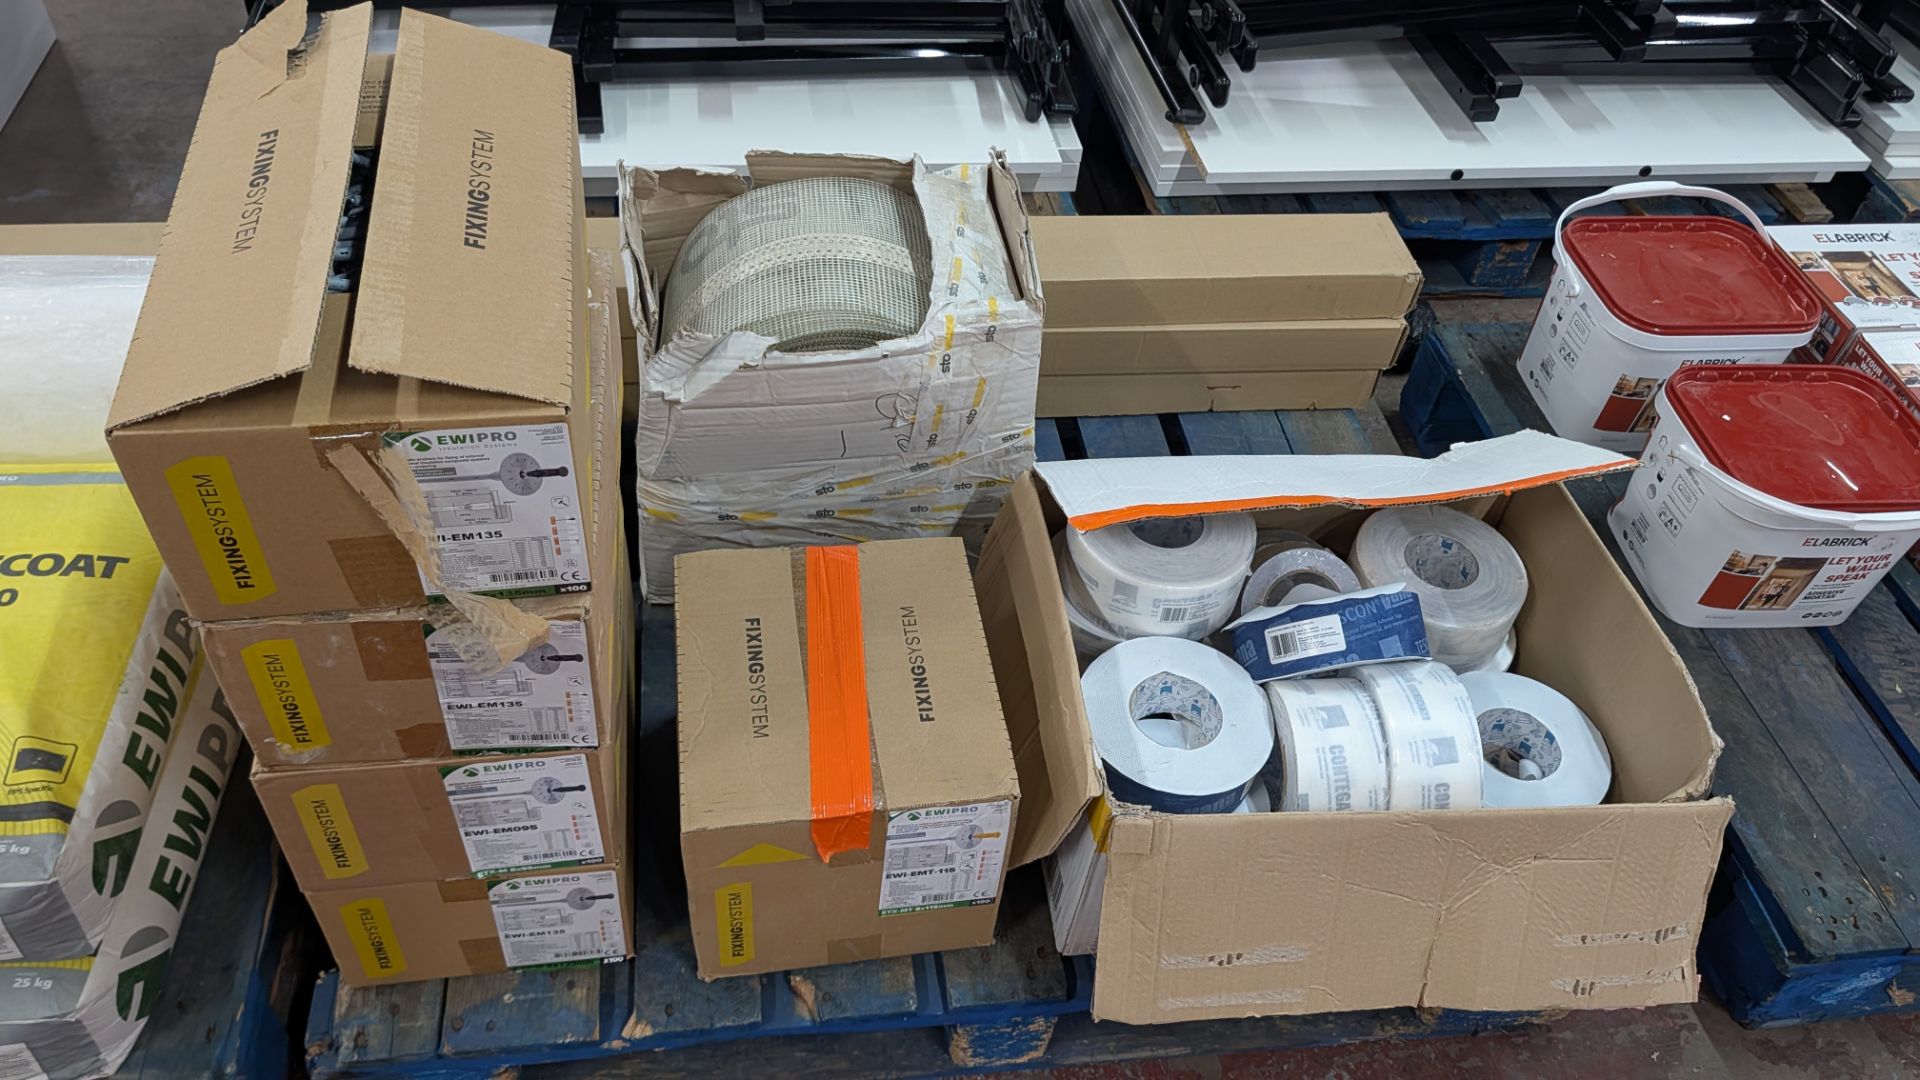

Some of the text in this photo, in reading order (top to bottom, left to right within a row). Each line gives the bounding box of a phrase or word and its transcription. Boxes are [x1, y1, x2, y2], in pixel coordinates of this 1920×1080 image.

[231, 129, 279, 254] FIXINGSYSTEM
[463, 129, 496, 250] FIXINGSYSTEM
[1812, 232, 1896, 243] ELABRICK
[1879, 252, 1907, 262] LET
[986, 325, 996, 342] sto
[940, 353, 951, 373] sto
[1855, 344, 1883, 377] LET YOUR
[436, 431, 517, 446] EWIPRO
[1002, 432, 1021, 443] sto
[815, 484, 835, 496] sto
[954, 481, 973, 490] sto
[816, 508, 835, 517] sto
[910, 505, 929, 513] sto
[718, 512, 738, 522] sto
[192, 474, 256, 589] FIXINGSYSTEM
[436, 530, 503, 543] I-EM135
[1802, 537, 1871, 548] ELABRICK
[1828, 553, 1893, 566] LET YOUR
[0, 554, 130, 579] COAT
[1846, 561, 1891, 574] WALLS
[1824, 572, 1870, 583] SPEAK
[560, 584, 588, 592] x100
[900, 606, 936, 723] FIXINGSYSTEM
[744, 617, 770, 739] FIXINGSYSTEM
[262, 654, 312, 744] FIXINGSYSTEM
[483, 760, 546, 773] EWIPRO
[925, 806, 978, 817] EWIPRO
[311, 799, 352, 869] FIXINGSYSTEM
[464, 824, 539, 838] EWI-EM095
[10, 844, 31, 855] kg
[885, 867, 956, 880] EWI-EMT-115
[524, 876, 581, 887] EWIPRO
[728, 892, 745, 957] FIXINGSYSTEM
[357, 908, 393, 970] FIXINGSYSTEM
[12, 977, 53, 990] 25 kg
